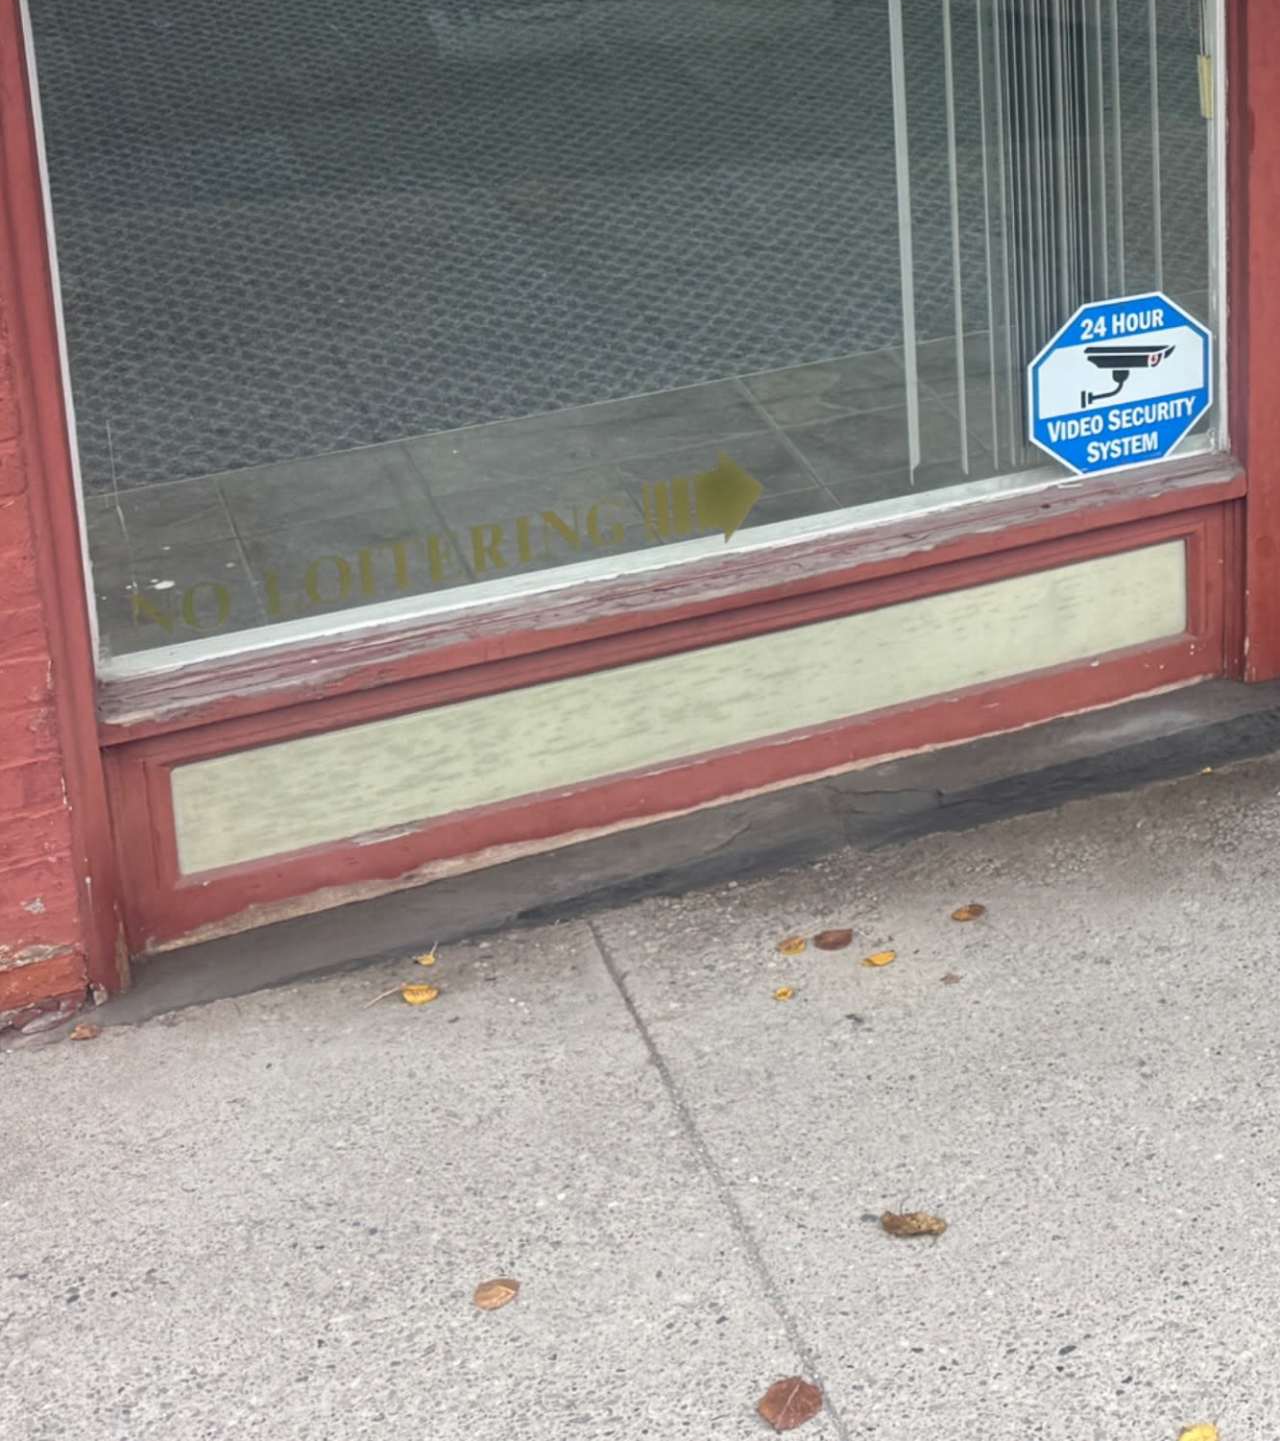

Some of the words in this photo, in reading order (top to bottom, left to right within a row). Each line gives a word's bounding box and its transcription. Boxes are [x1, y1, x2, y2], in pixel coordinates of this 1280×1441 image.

[1080, 315, 1107, 340] 24
[1112, 308, 1164, 335] HOUR
[1047, 415, 1104, 443] VIDEO
[1108, 395, 1196, 432] SECURITY
[1087, 431, 1159, 463] SYSTEM
[130, 581, 231, 635] NO
[263, 497, 625, 618] LOITERING
